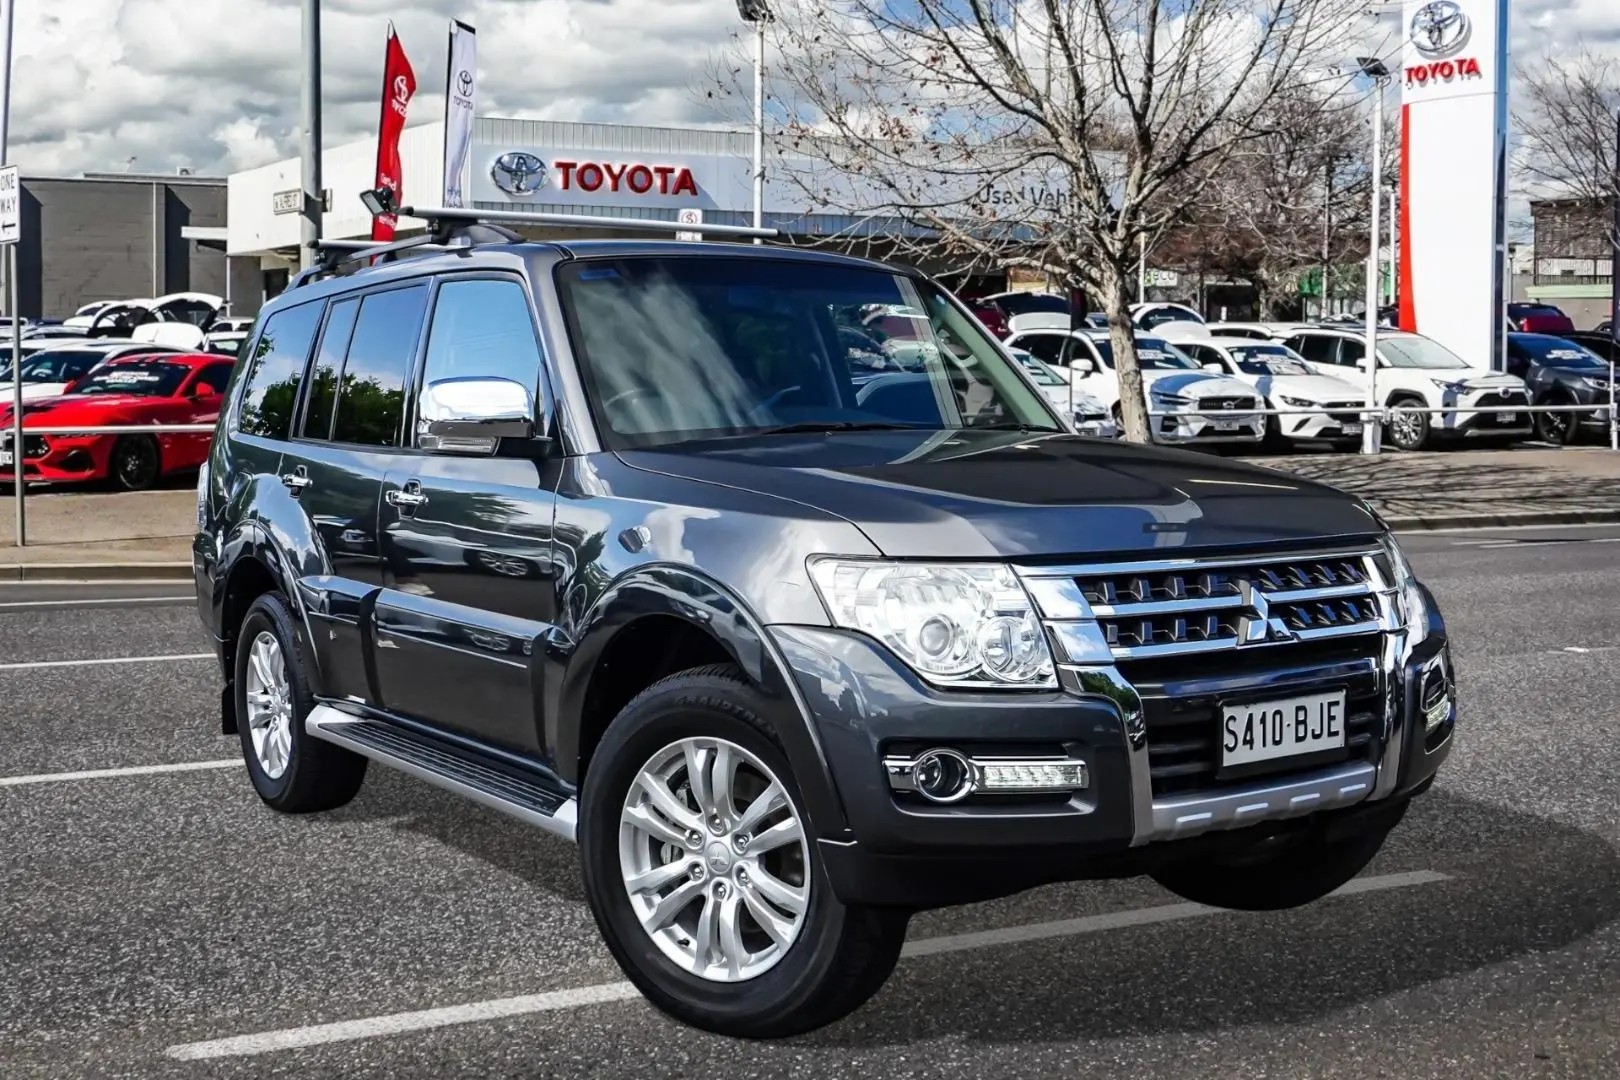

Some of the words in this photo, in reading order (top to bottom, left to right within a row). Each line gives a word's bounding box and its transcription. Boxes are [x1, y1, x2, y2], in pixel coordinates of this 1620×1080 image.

[1404, 58, 1482, 83] TOYOTA
[1, 172, 15, 191] ONE
[555, 162, 698, 196] TOYOTA
[1, 196, 16, 213] WAY
